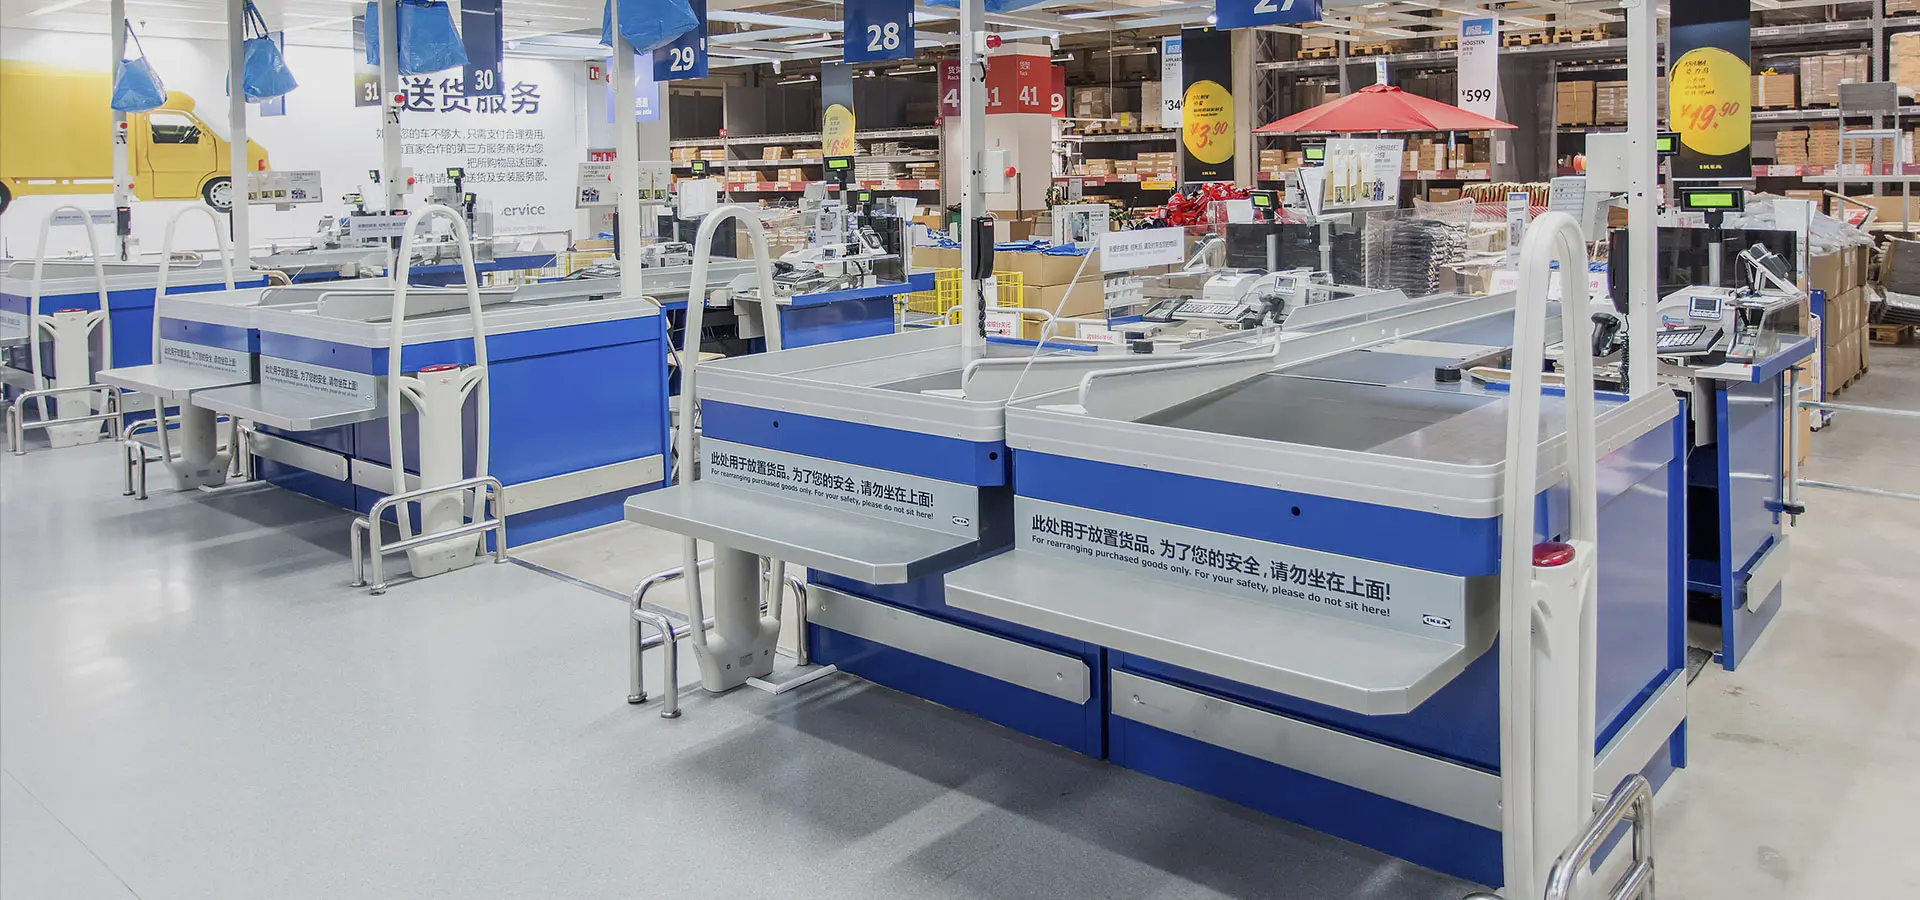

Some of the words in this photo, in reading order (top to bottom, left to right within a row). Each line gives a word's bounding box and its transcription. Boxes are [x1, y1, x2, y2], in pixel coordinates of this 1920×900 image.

[867, 22, 900, 52] 28
[669, 46, 695, 73] 29
[364, 82, 380, 102] 31
[474, 69, 494, 91] 30
[1019, 85, 1039, 106] 41
[1165, 99, 1183, 111] ¥34
[1461, 88, 1492, 103] ¥599
[1680, 101, 1740, 131] ¥19.90
[1191, 120, 1229, 149] ¥3.90
[501, 203, 546, 217] ervice
[710, 467, 720, 476] For
[720, 469, 751, 484] rearranging
[751, 477, 780, 489] purchased
[781, 483, 799, 493] goods
[799, 487, 814, 496] only.
[814, 488, 825, 497] For
[825, 491, 839, 501] your
[839, 495, 861, 506] safety,
[861, 499, 882, 510] please
[883, 503, 893, 512] do
[893, 506, 905, 515] not
[905, 508, 915, 517] sit
[915, 510, 934, 520] here!
[1031, 535, 1045, 544] For
[1046, 539, 1094, 557] rearranging
[1095, 549, 1140, 565] purchased
[1142, 557, 1169, 571] goods
[1170, 563, 1192, 576] only.
[1194, 568, 1211, 580] For
[1212, 573, 1234, 586] your
[1236, 577, 1269, 594] safety,
[1272, 584, 1306, 600] please
[1307, 591, 1321, 603] do
[1323, 596, 1342, 607] not
[1344, 599, 1360, 611] sit
[1361, 603, 1391, 618] here!
